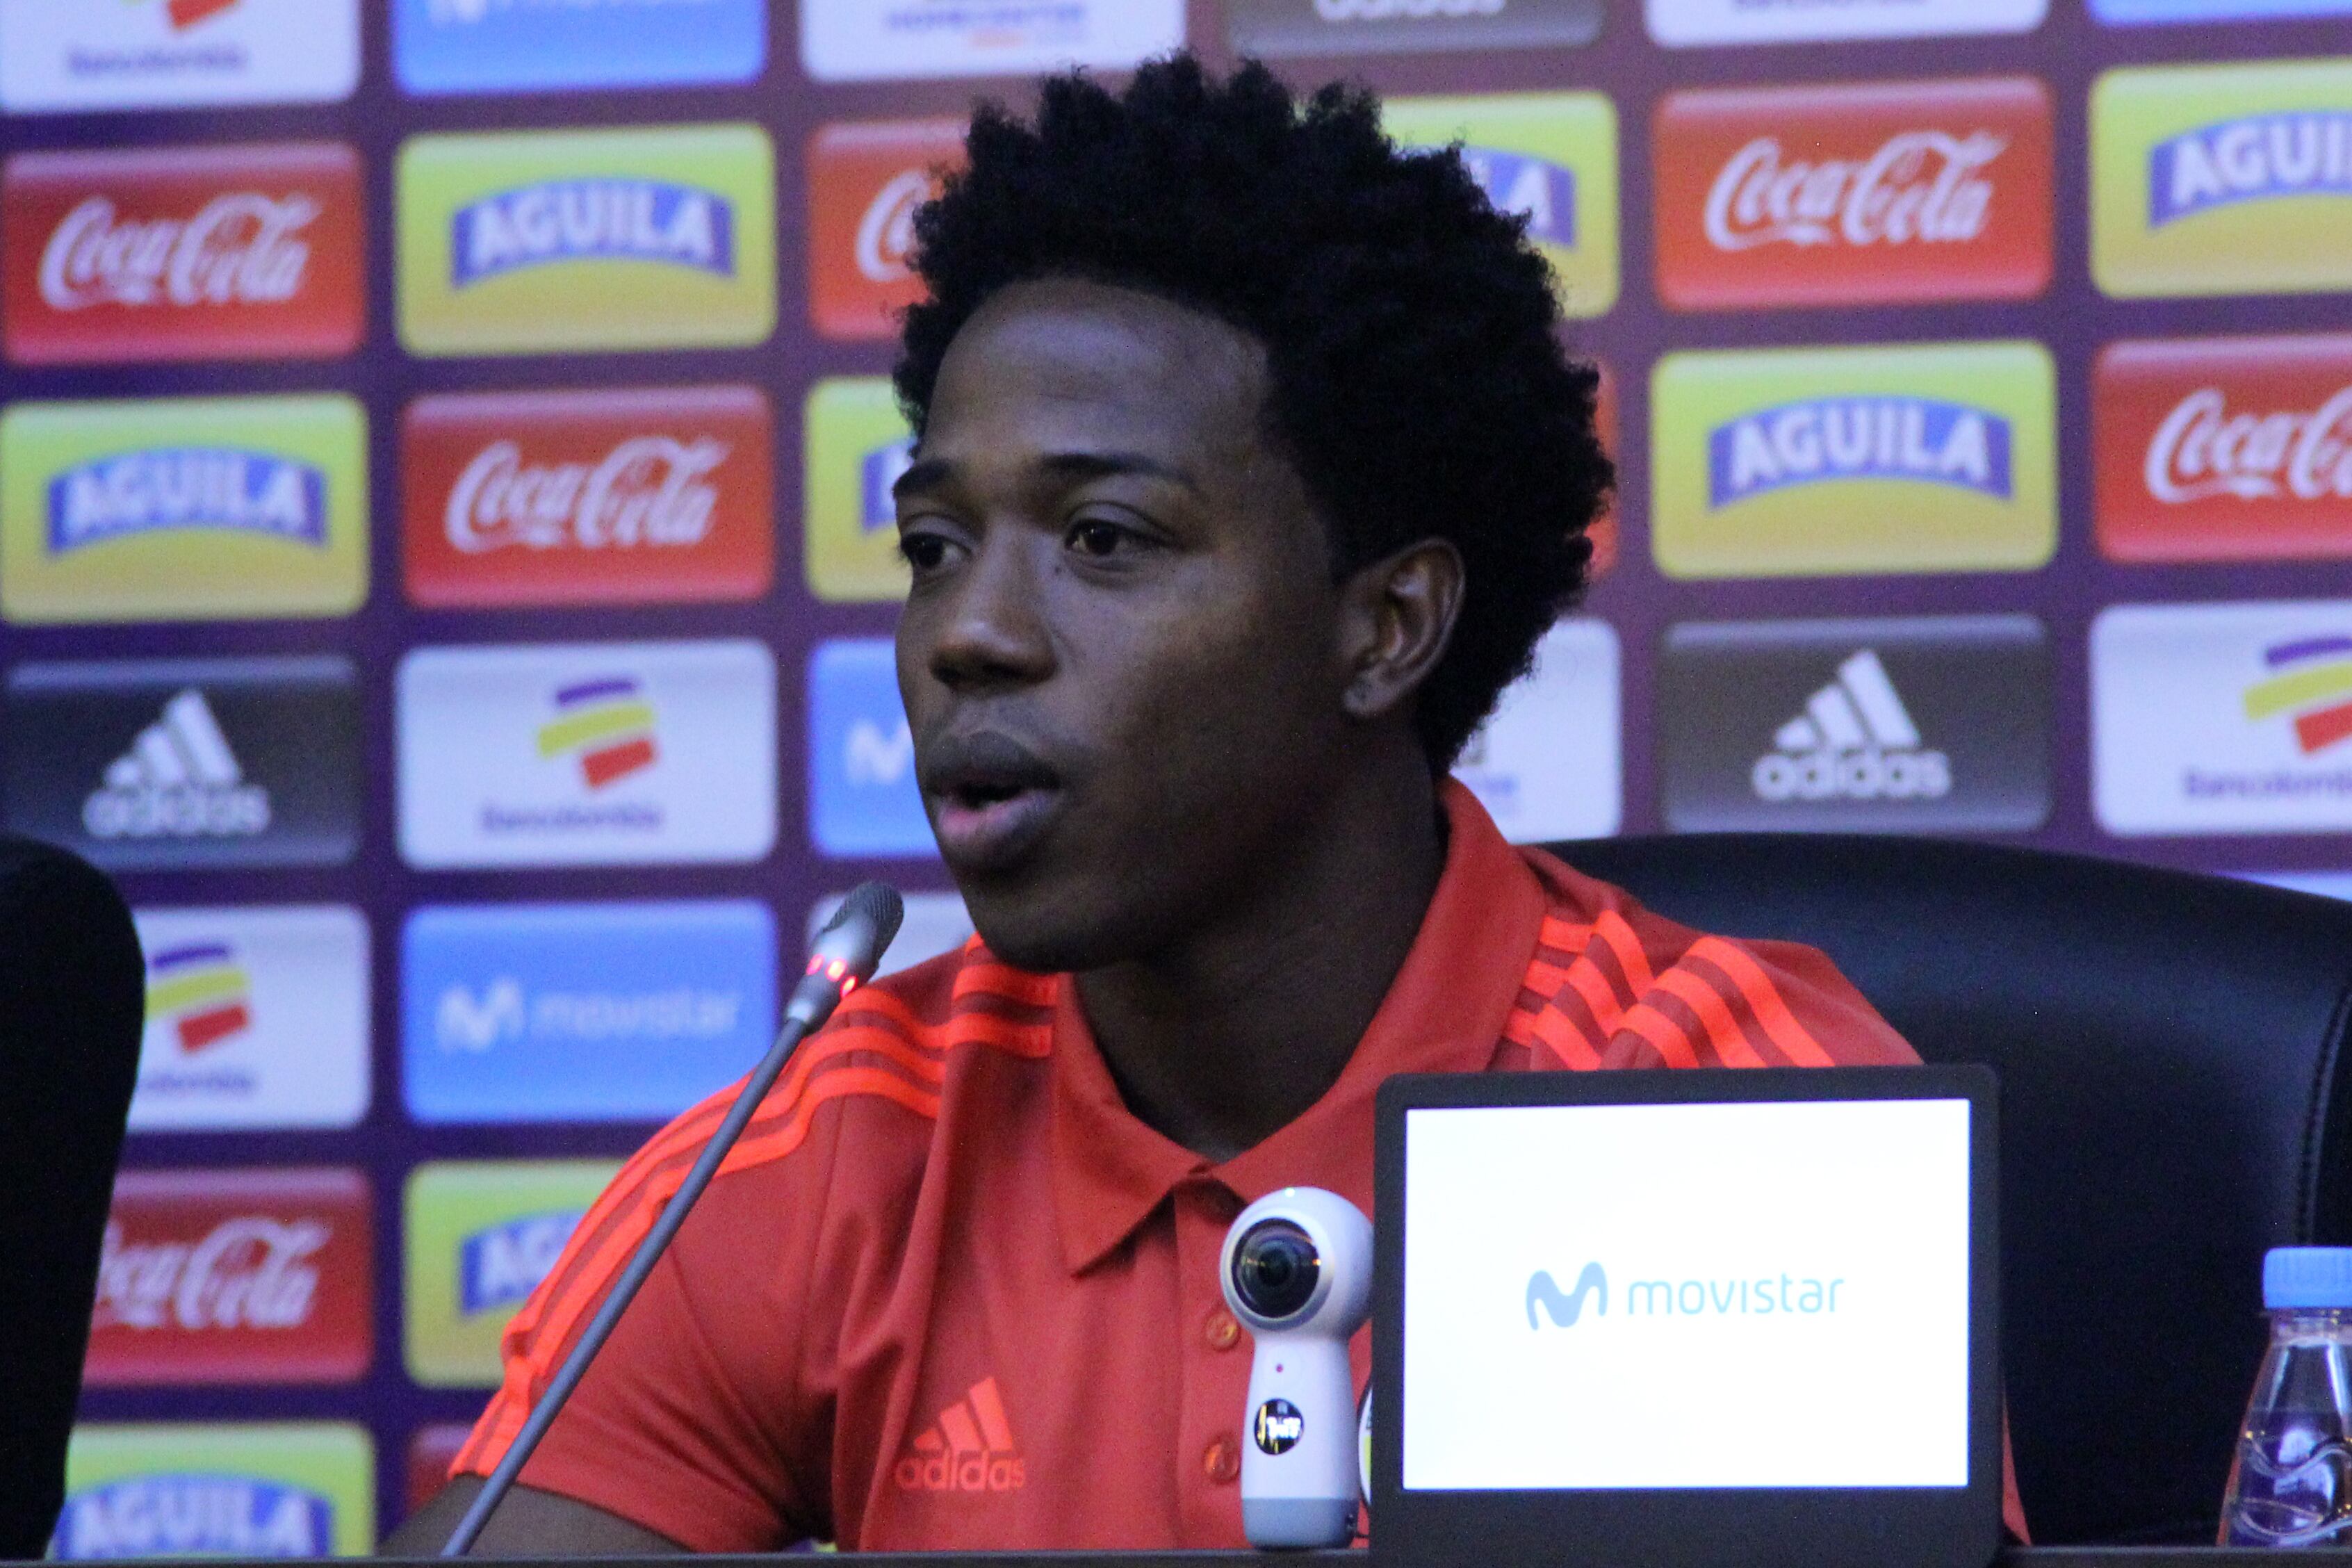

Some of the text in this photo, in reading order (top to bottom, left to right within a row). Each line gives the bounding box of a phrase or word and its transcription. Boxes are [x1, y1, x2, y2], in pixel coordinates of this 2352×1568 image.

[2170, 117, 2352, 206] AGUI
[469, 179, 714, 271] AGUILA
[1731, 399, 1988, 491] AGUILA
[63, 450, 307, 541] AGUILA
[1751, 744, 1951, 801] adidas
[83, 783, 270, 838] adidas
[1626, 1273, 1845, 1316] movistar
[895, 1448, 1025, 1492] adidas
